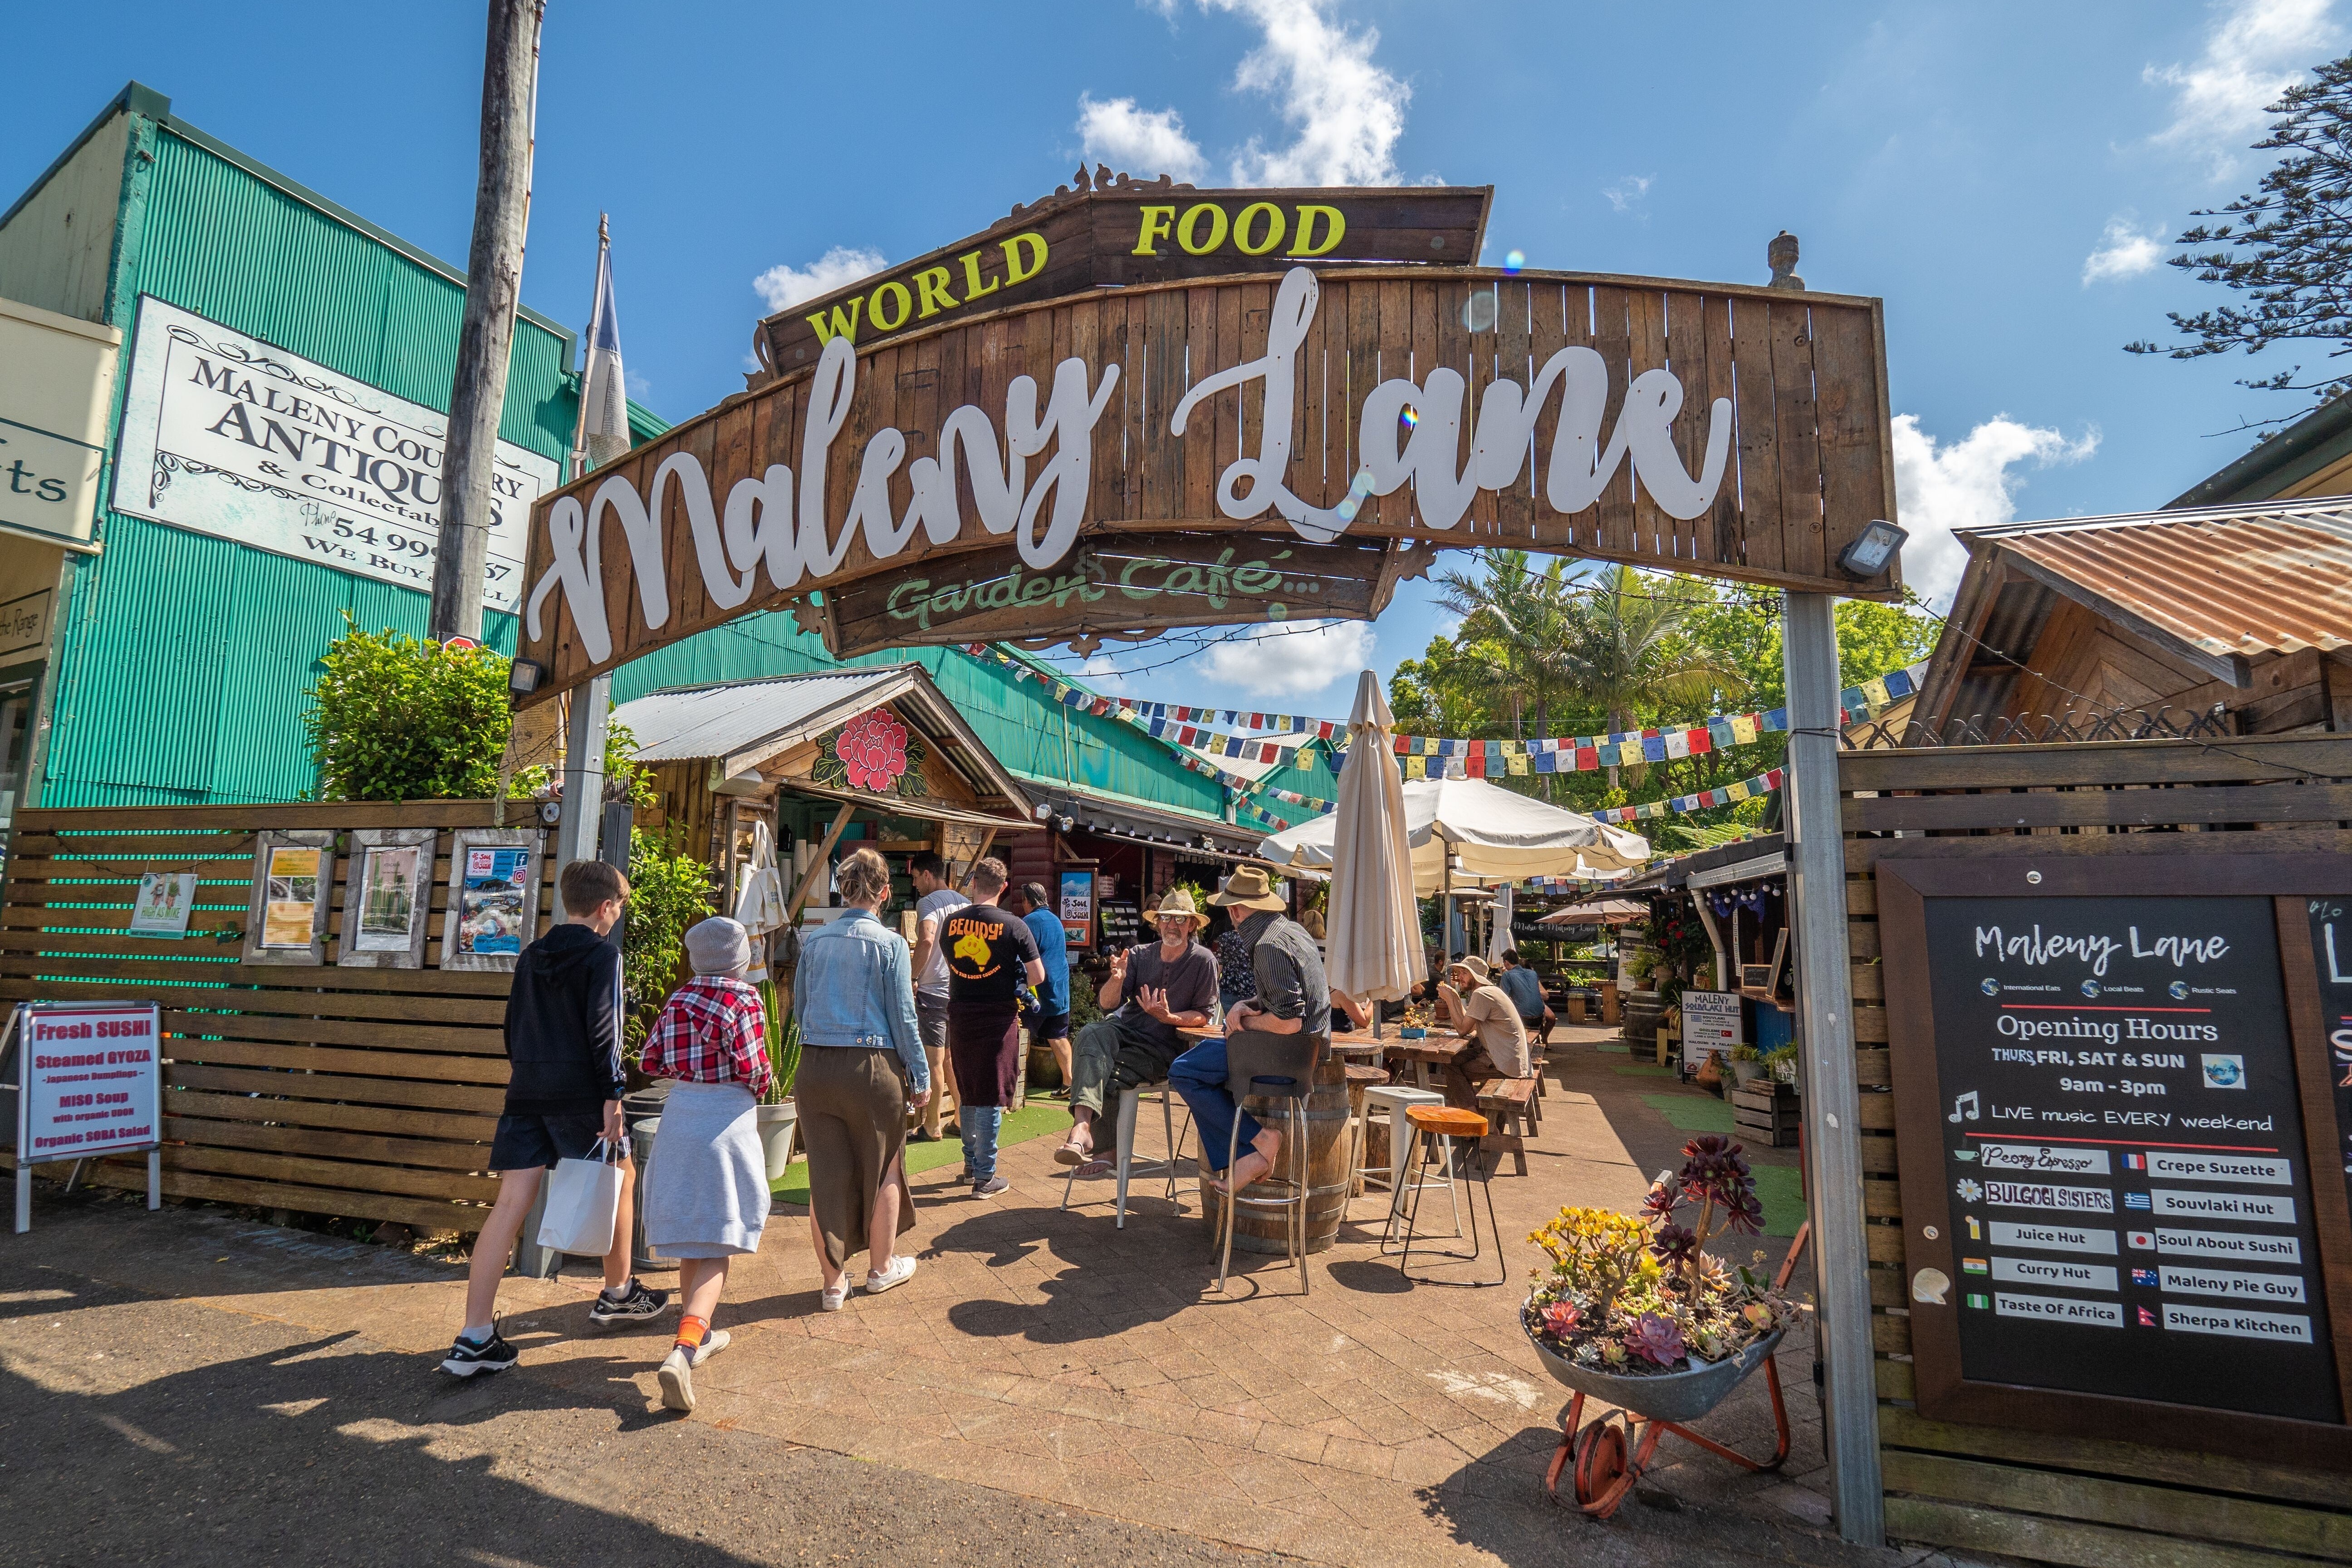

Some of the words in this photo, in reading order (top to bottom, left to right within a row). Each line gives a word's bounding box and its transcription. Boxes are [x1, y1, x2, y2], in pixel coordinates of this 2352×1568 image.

[806, 233, 1049, 348] WORLD
[1132, 203, 1347, 257] FOOD
[188, 356, 367, 441] MALENY
[372, 426, 525, 500] COURY
[205, 402, 503, 527] ANTIQUS
[528, 336, 1120, 664] Maleny
[1171, 267, 1733, 543] Lane
[258, 461, 291, 479] &
[301, 474, 440, 528] Collectab
[299, 502, 337, 526] Phone
[300, 534, 356, 561] WE
[366, 552, 426, 579] BUY
[887, 563, 1106, 631] Garden
[12, 608, 38, 638] Range
[141, 906, 156, 917] HIGH
[156, 906, 165, 918] AS
[165, 907, 182, 918] MIKE
[1514, 921, 1537, 931] Music
[1547, 923, 1575, 934] Maleny
[1975, 924, 2122, 976] Maleny
[2129, 926, 2231, 967] Lane
[1685, 1002, 1722, 1013] SOUVLAKI
[1725, 1005, 1740, 1013] HUT
[1695, 994, 1730, 1004] MALENY
[36, 1022, 93, 1041] Fresh
[96, 1019, 151, 1038] SUSHI
[1997, 1014, 2120, 1044] Opening
[2124, 1018, 2219, 1041] Hours
[35, 1051, 105, 1069] Steamed
[107, 1049, 152, 1064] GYOZA
[2036, 1050, 2075, 1067] FRI,
[2078, 1052, 2117, 1066] SAT
[2121, 1053, 2138, 1067] &
[2141, 1054, 2185, 1068] SUN
[91, 1069, 137, 1081] Dumplings
[2059, 1077, 2104, 1093] 9am
[2120, 1079, 2166, 1097] 3pm
[59, 1093, 93, 1108] MISO
[96, 1092, 129, 1104] Soup
[53, 1113, 73, 1124] with
[74, 1110, 110, 1121] organic
[111, 1107, 135, 1117] UDON
[1991, 1105, 2034, 1120] LIVE
[2042, 1109, 2097, 1123] music
[2104, 1111, 2171, 1127] EVERY
[2180, 1114, 2273, 1131] weekend
[34, 1133, 83, 1148] Organic
[85, 1128, 117, 1142] SOBA
[118, 1124, 151, 1138] Salad
[2157, 1159, 2205, 1174] Crepe
[2209, 1162, 2276, 1176] Suzette
[1986, 1183, 2057, 1207] BULGOGI
[2058, 1188, 2112, 1210] SISTERS
[2166, 1197, 2238, 1212] Souvlaki
[2243, 1201, 2274, 1215] Hut
[2016, 1228, 2054, 1241] Juice
[2058, 1231, 2086, 1244] Hut
[2158, 1235, 2192, 1247] Soul
[2196, 1237, 2245, 1251] About
[2248, 1240, 2293, 1254] Sushi
[2017, 1263, 2059, 1279] Curry
[2063, 1267, 2091, 1279] Hut
[2167, 1274, 2229, 1293] Maleny
[2233, 1279, 2260, 1293] Pie
[2264, 1282, 2298, 1298] Guy
[1999, 1298, 2042, 1313] Taste
[2067, 1305, 2116, 1320] Africa
[2169, 1312, 2230, 1329] Sherpa
[2234, 1318, 2302, 1335] Kitchen
